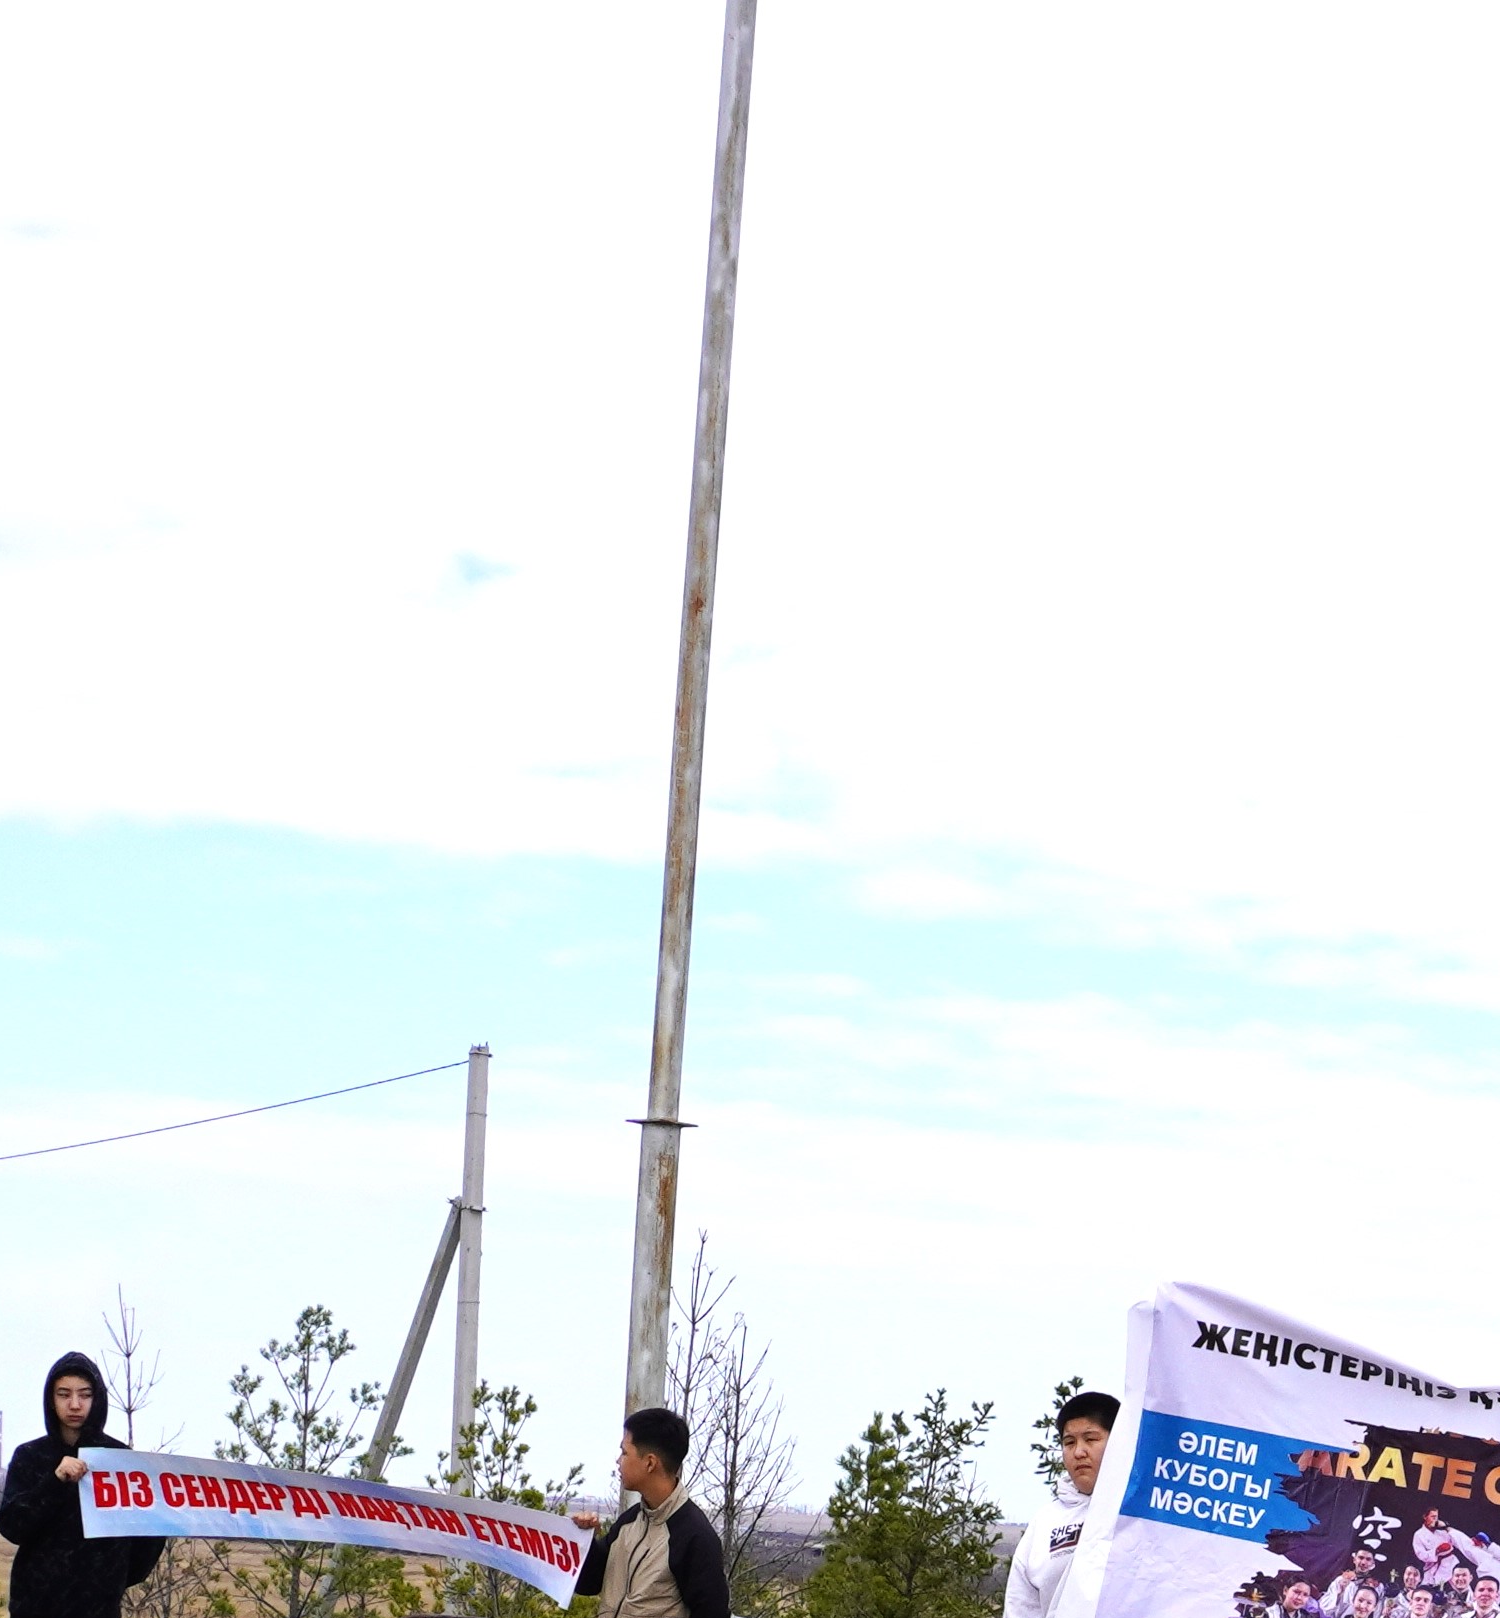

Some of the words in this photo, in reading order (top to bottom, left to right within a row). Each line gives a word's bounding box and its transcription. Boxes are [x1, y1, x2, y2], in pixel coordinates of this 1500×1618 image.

[1192, 1320, 1457, 1399] ЖЕҢІСТЕРІҢІЗ
[1178, 1431, 1258, 1466] ӘЛЕМ
[1153, 1456, 1272, 1500] КУБОГЫ
[92, 1471, 154, 1508] БІЗ
[159, 1472, 331, 1519] СЕНДЕРДІ
[326, 1491, 467, 1530] МАҚТАН
[464, 1513, 581, 1576] ЕТЕМІЗ!
[1149, 1486, 1266, 1529] МӘСКЕУ
